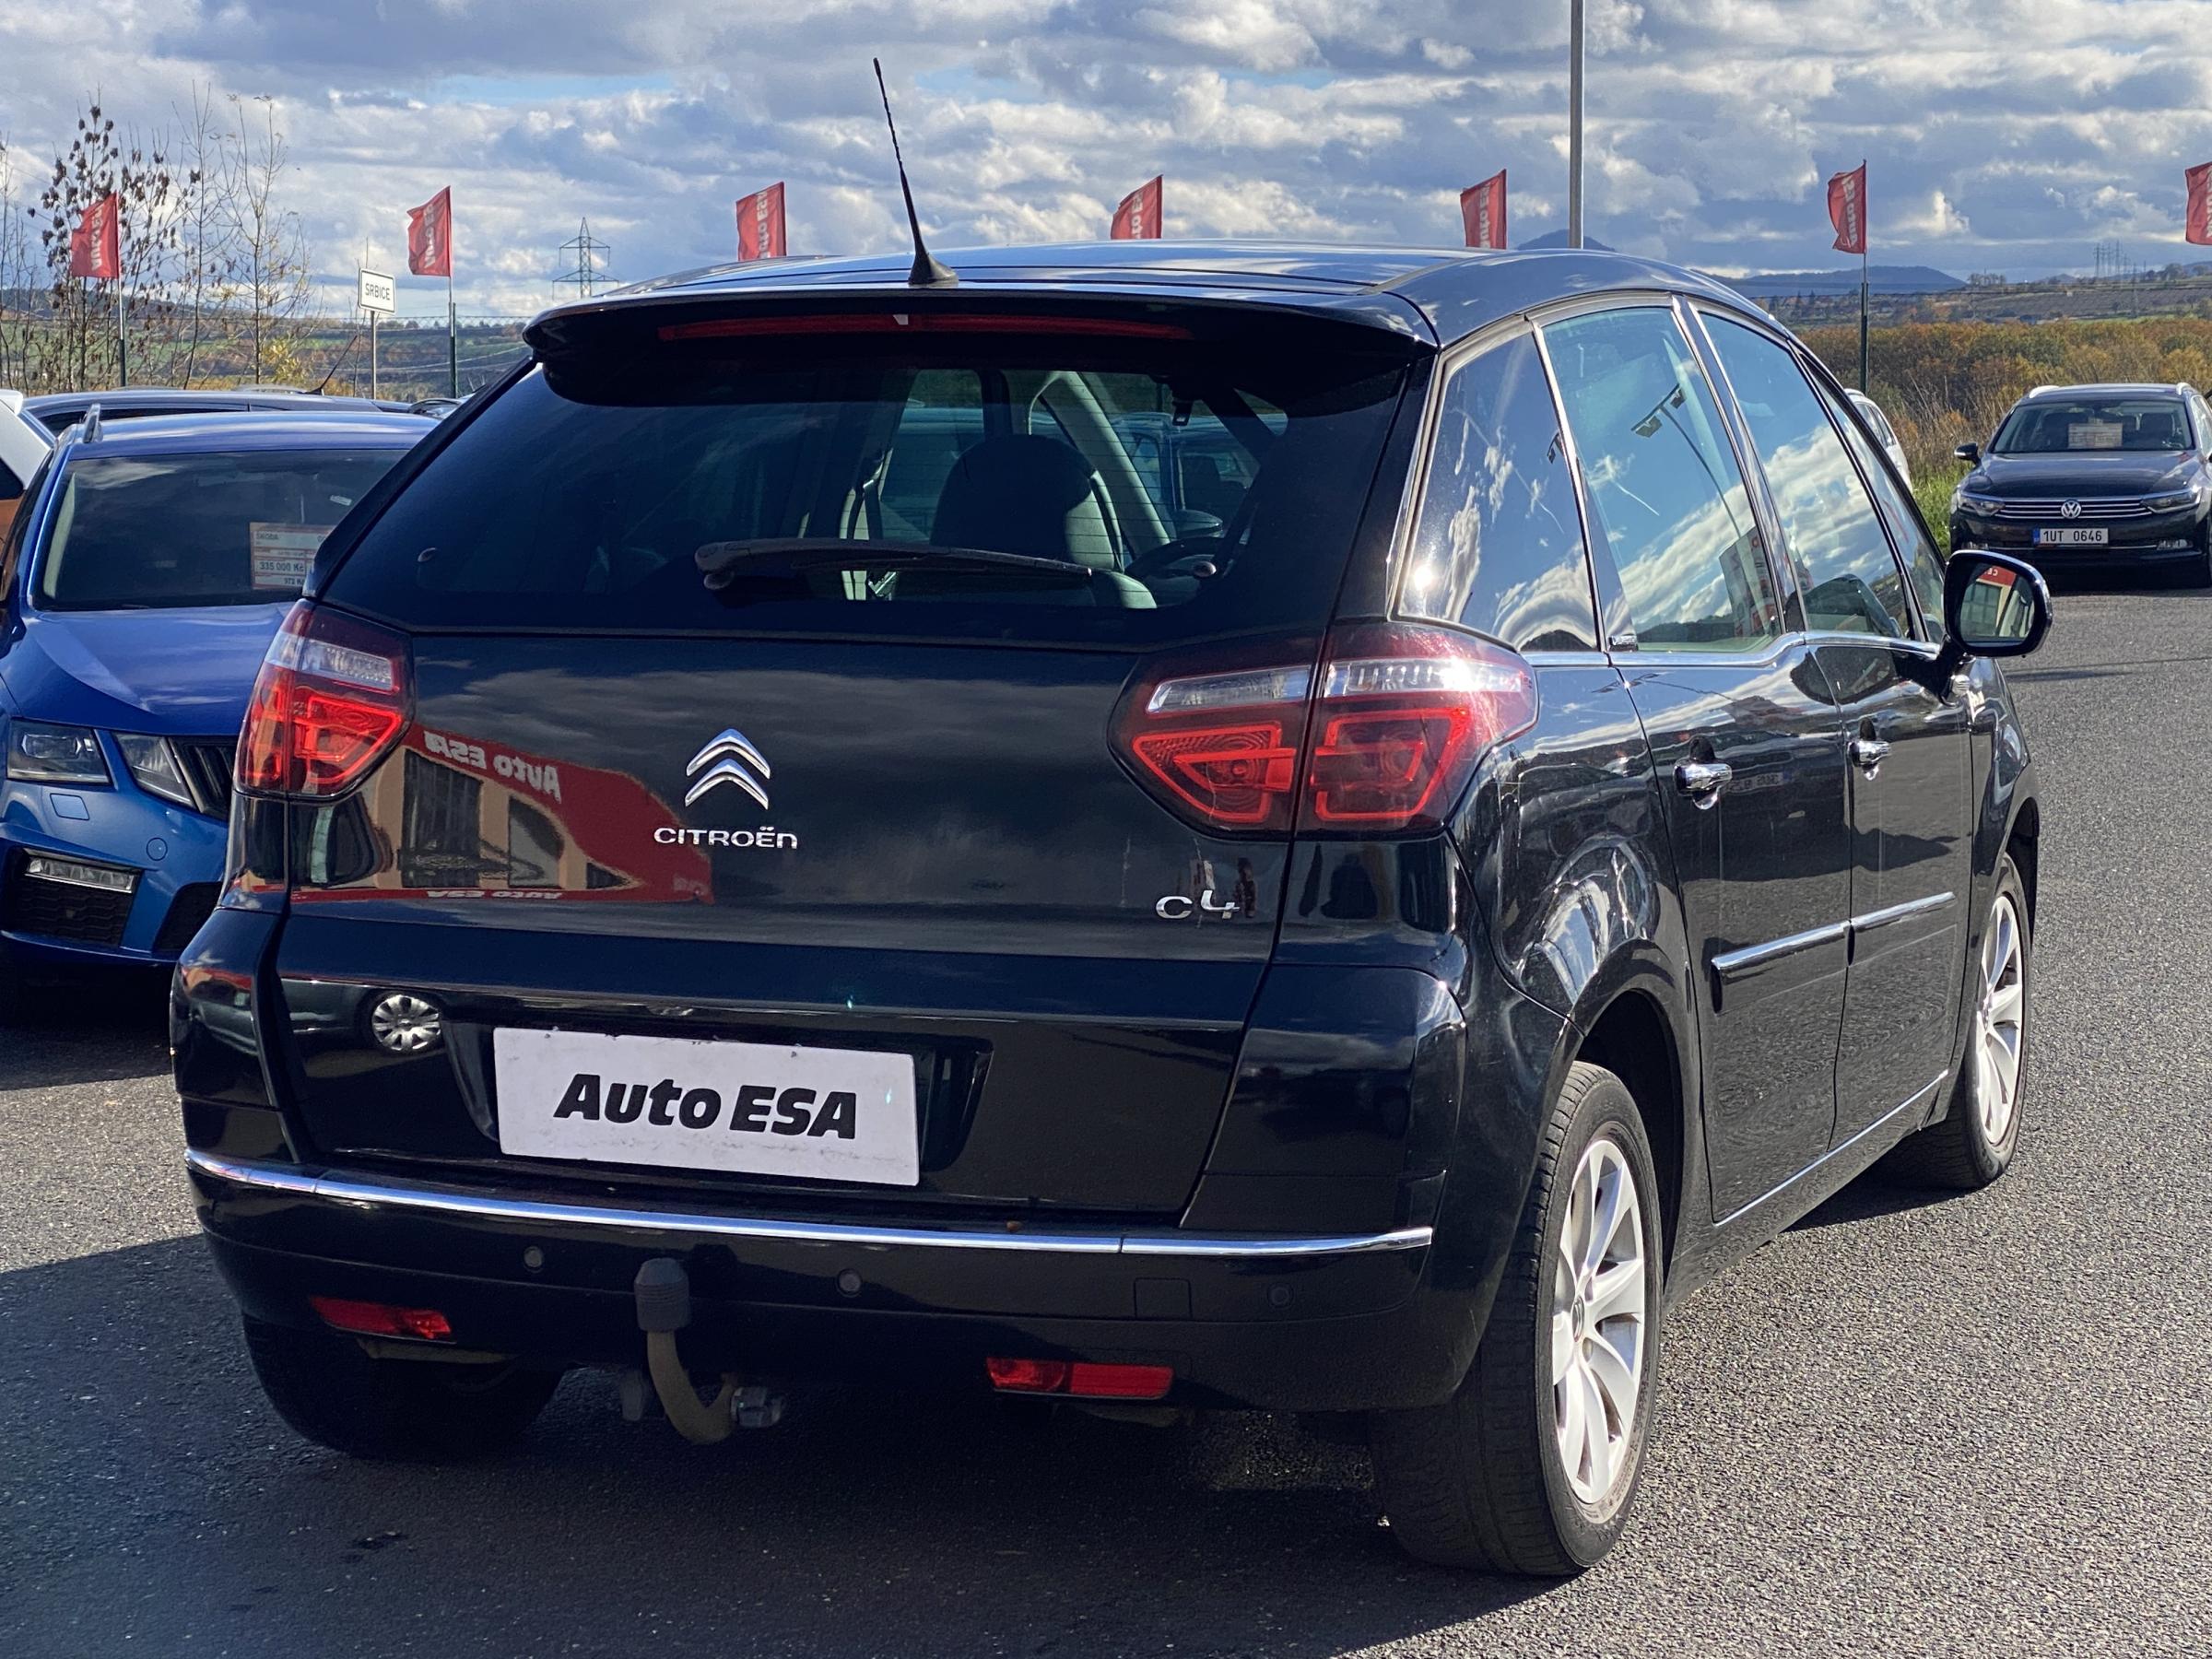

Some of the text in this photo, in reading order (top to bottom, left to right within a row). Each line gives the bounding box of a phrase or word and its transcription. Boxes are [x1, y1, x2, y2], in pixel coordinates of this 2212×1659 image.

[365, 282, 391, 300] SRBICE
[2042, 530, 2102, 542] 1UT 0646
[259, 560, 275, 571] 335
[276, 561, 291, 571] 000
[1156, 889, 1241, 920] C4
[553, 1074, 857, 1140] Auto ESA
